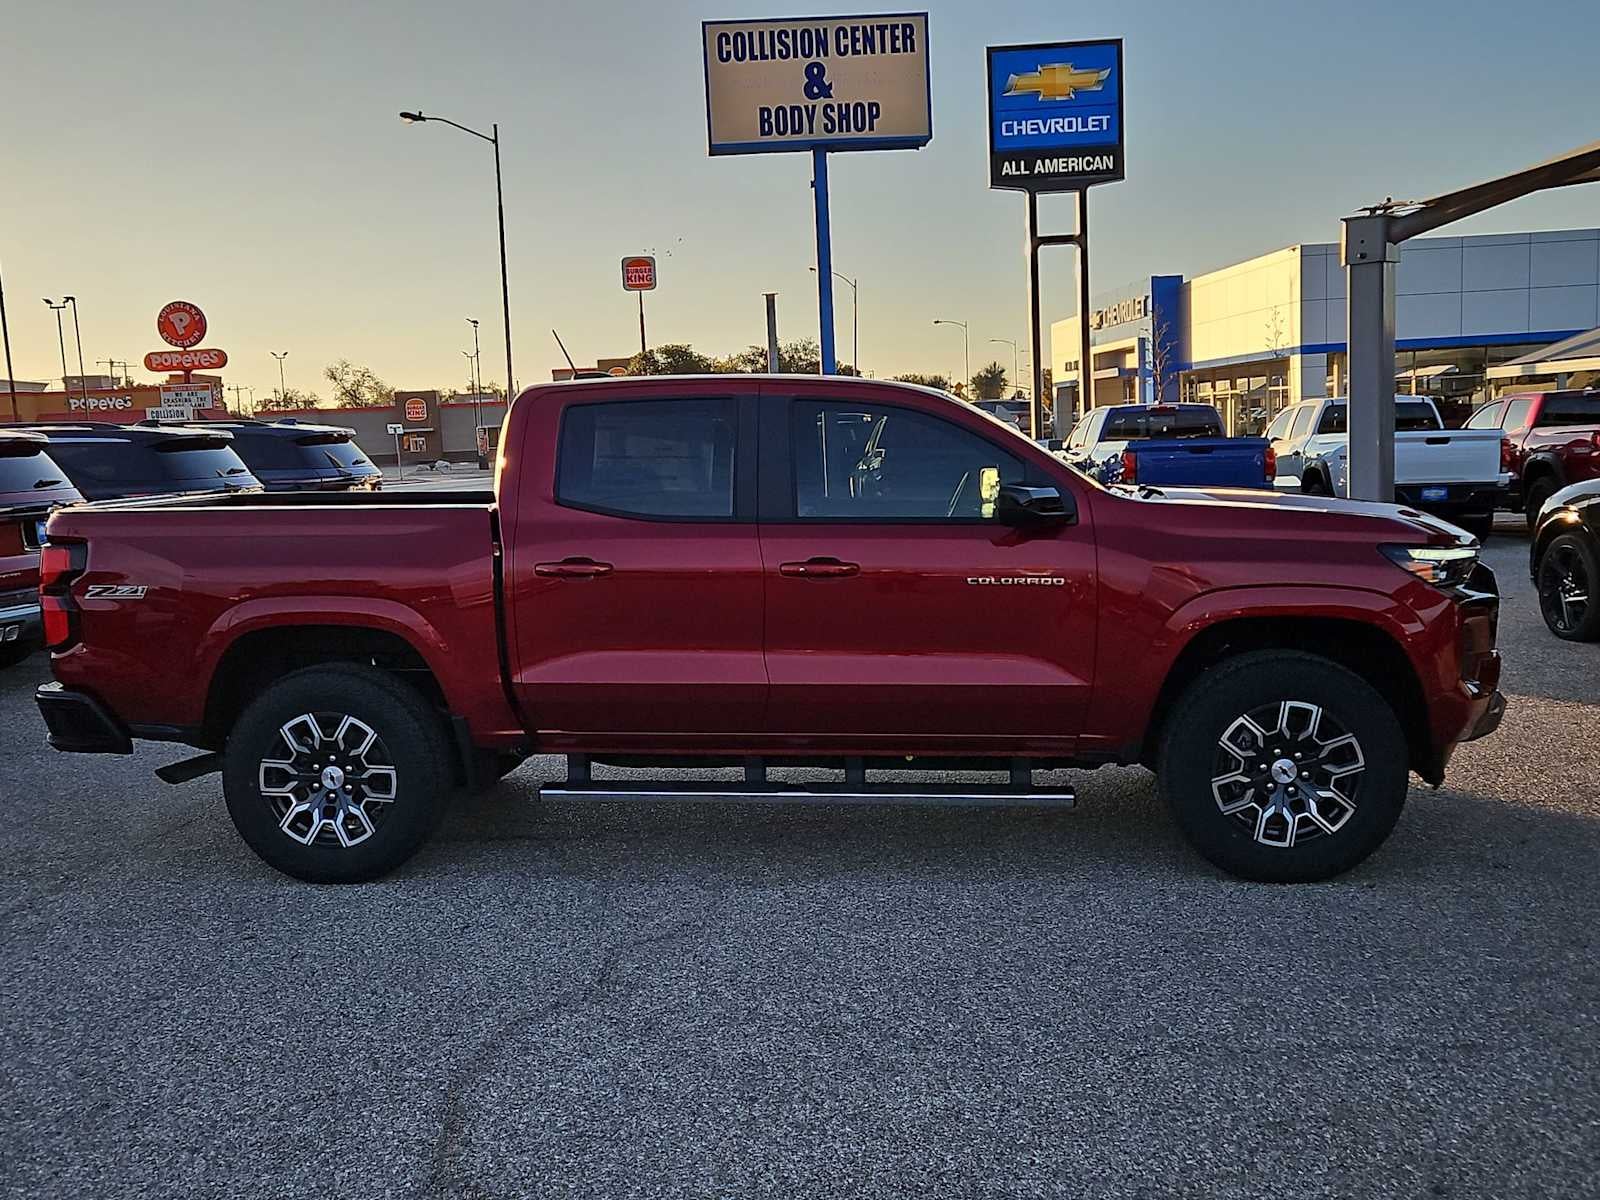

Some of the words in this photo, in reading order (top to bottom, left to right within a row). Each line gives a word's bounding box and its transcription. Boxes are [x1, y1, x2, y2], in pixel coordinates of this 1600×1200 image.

[717, 28, 829, 62] COLLISION
[835, 23, 916, 57] CENTER
[803, 62, 833, 100] &
[759, 104, 816, 136] BODY
[822, 102, 880, 134] SHOP
[1001, 115, 1111, 136] CHEVROLET
[1001, 160, 1030, 176] ALL
[1034, 155, 1114, 174] AMERICAN
[626, 267, 652, 275] BURGER
[626, 274, 653, 283] KING
[159, 302, 201, 322] LOUISIANA
[1102, 294, 1149, 327] CHEVROLET
[168, 311, 191, 336] P
[161, 329, 201, 346] KITCHEN
[151, 409, 185, 419] COLLISION
[966, 577, 1065, 586] COLORADO
[84, 584, 149, 600] Z71
